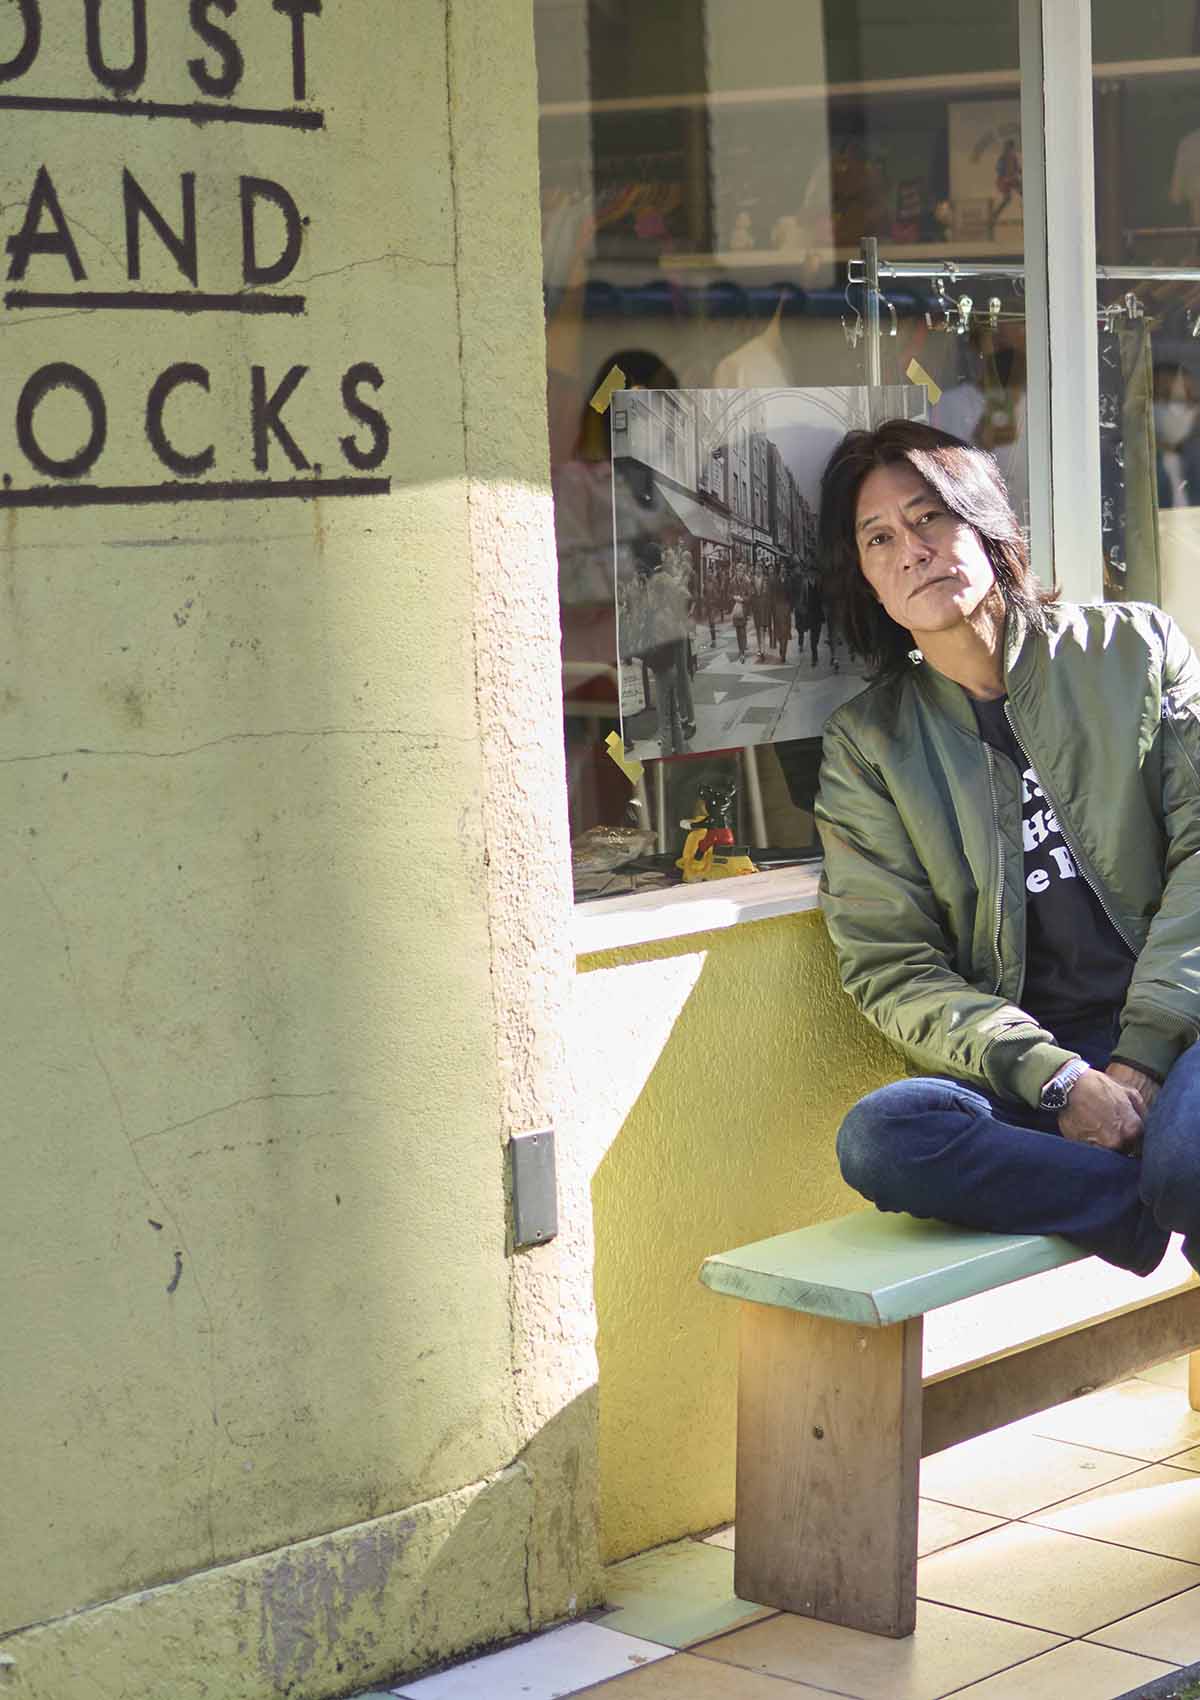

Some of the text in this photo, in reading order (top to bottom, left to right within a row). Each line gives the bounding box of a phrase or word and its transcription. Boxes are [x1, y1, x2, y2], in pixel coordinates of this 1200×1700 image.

[0, 0, 322, 101] DUST
[6, 165, 303, 287] AND
[0, 362, 390, 479] OCKS
